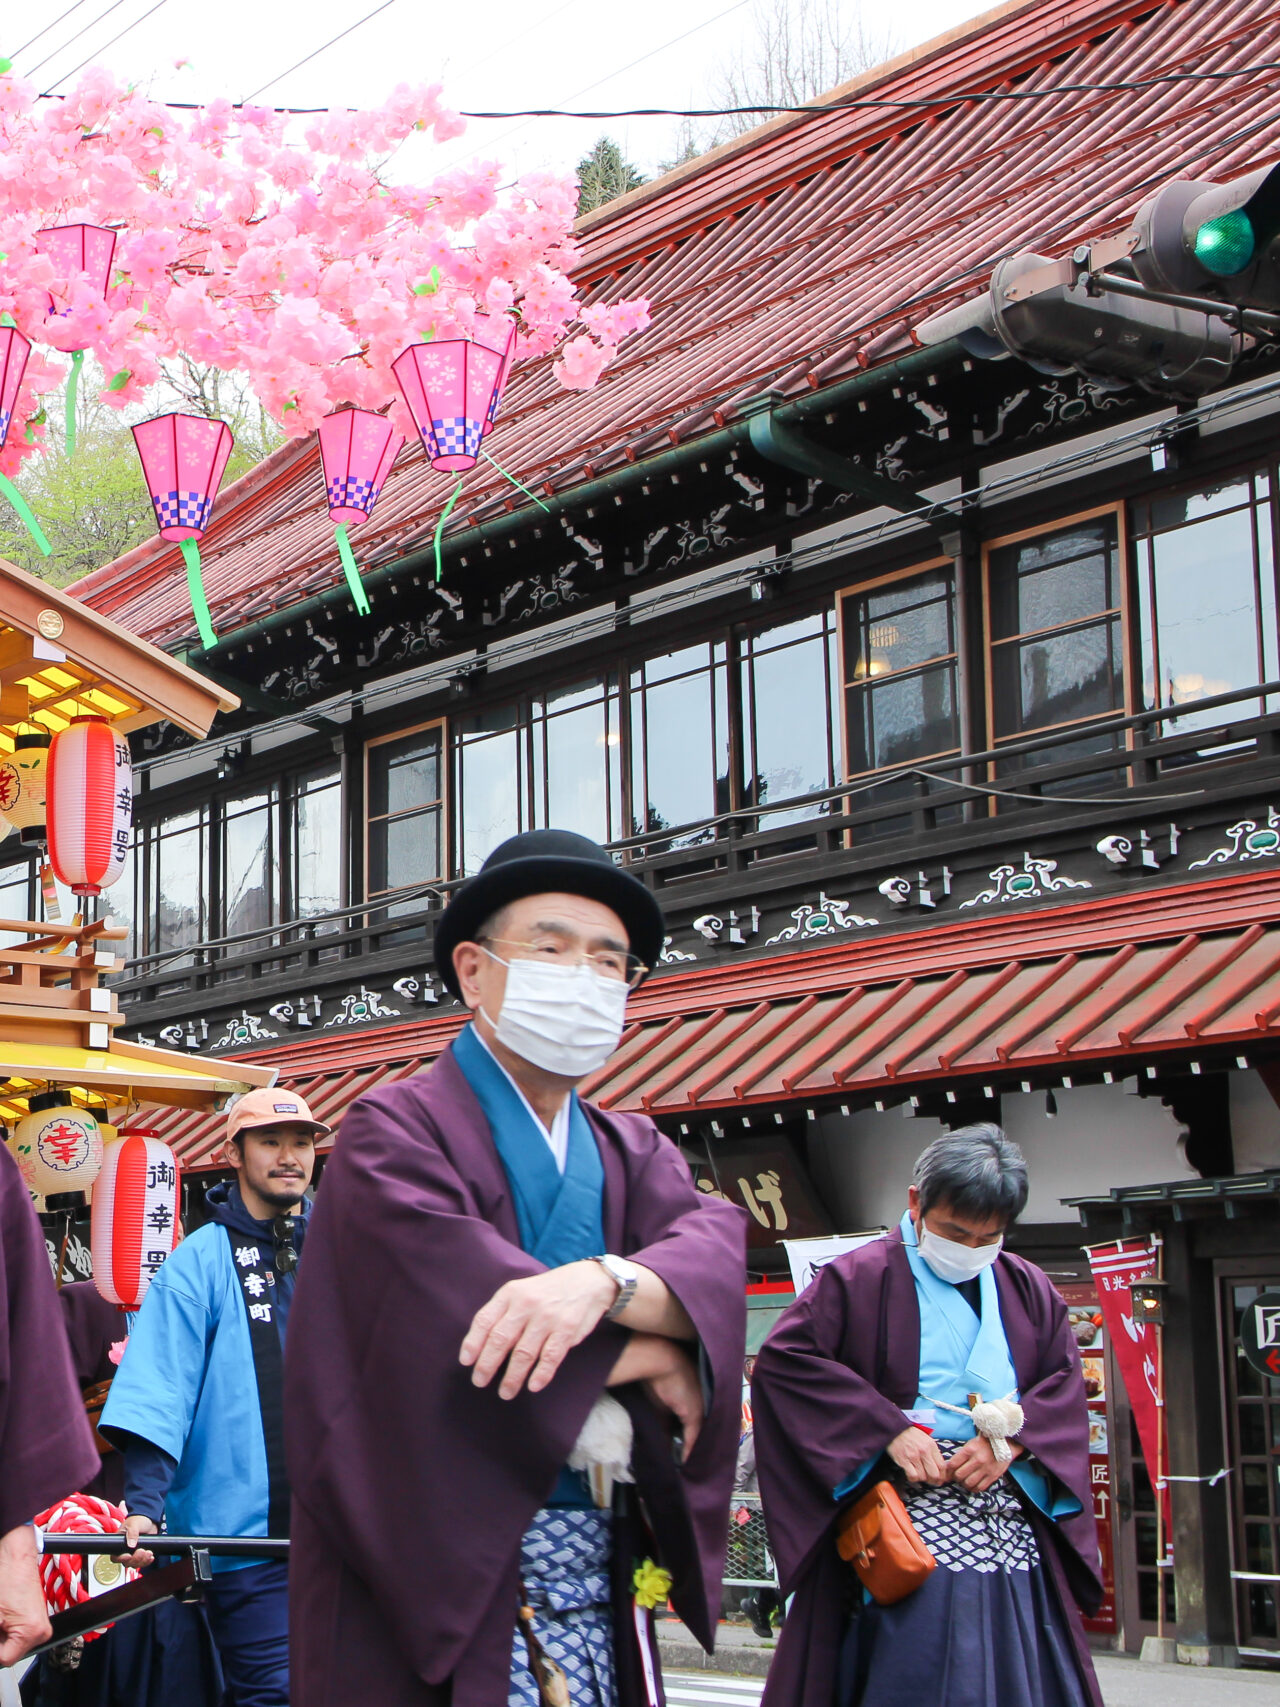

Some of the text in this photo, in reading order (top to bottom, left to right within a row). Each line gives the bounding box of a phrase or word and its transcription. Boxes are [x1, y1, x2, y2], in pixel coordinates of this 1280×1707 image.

[44, 1124, 84, 1165] 幸
[235, 1246, 272, 1322] 御幸町
[1092, 1464, 1110, 1484] 匠
